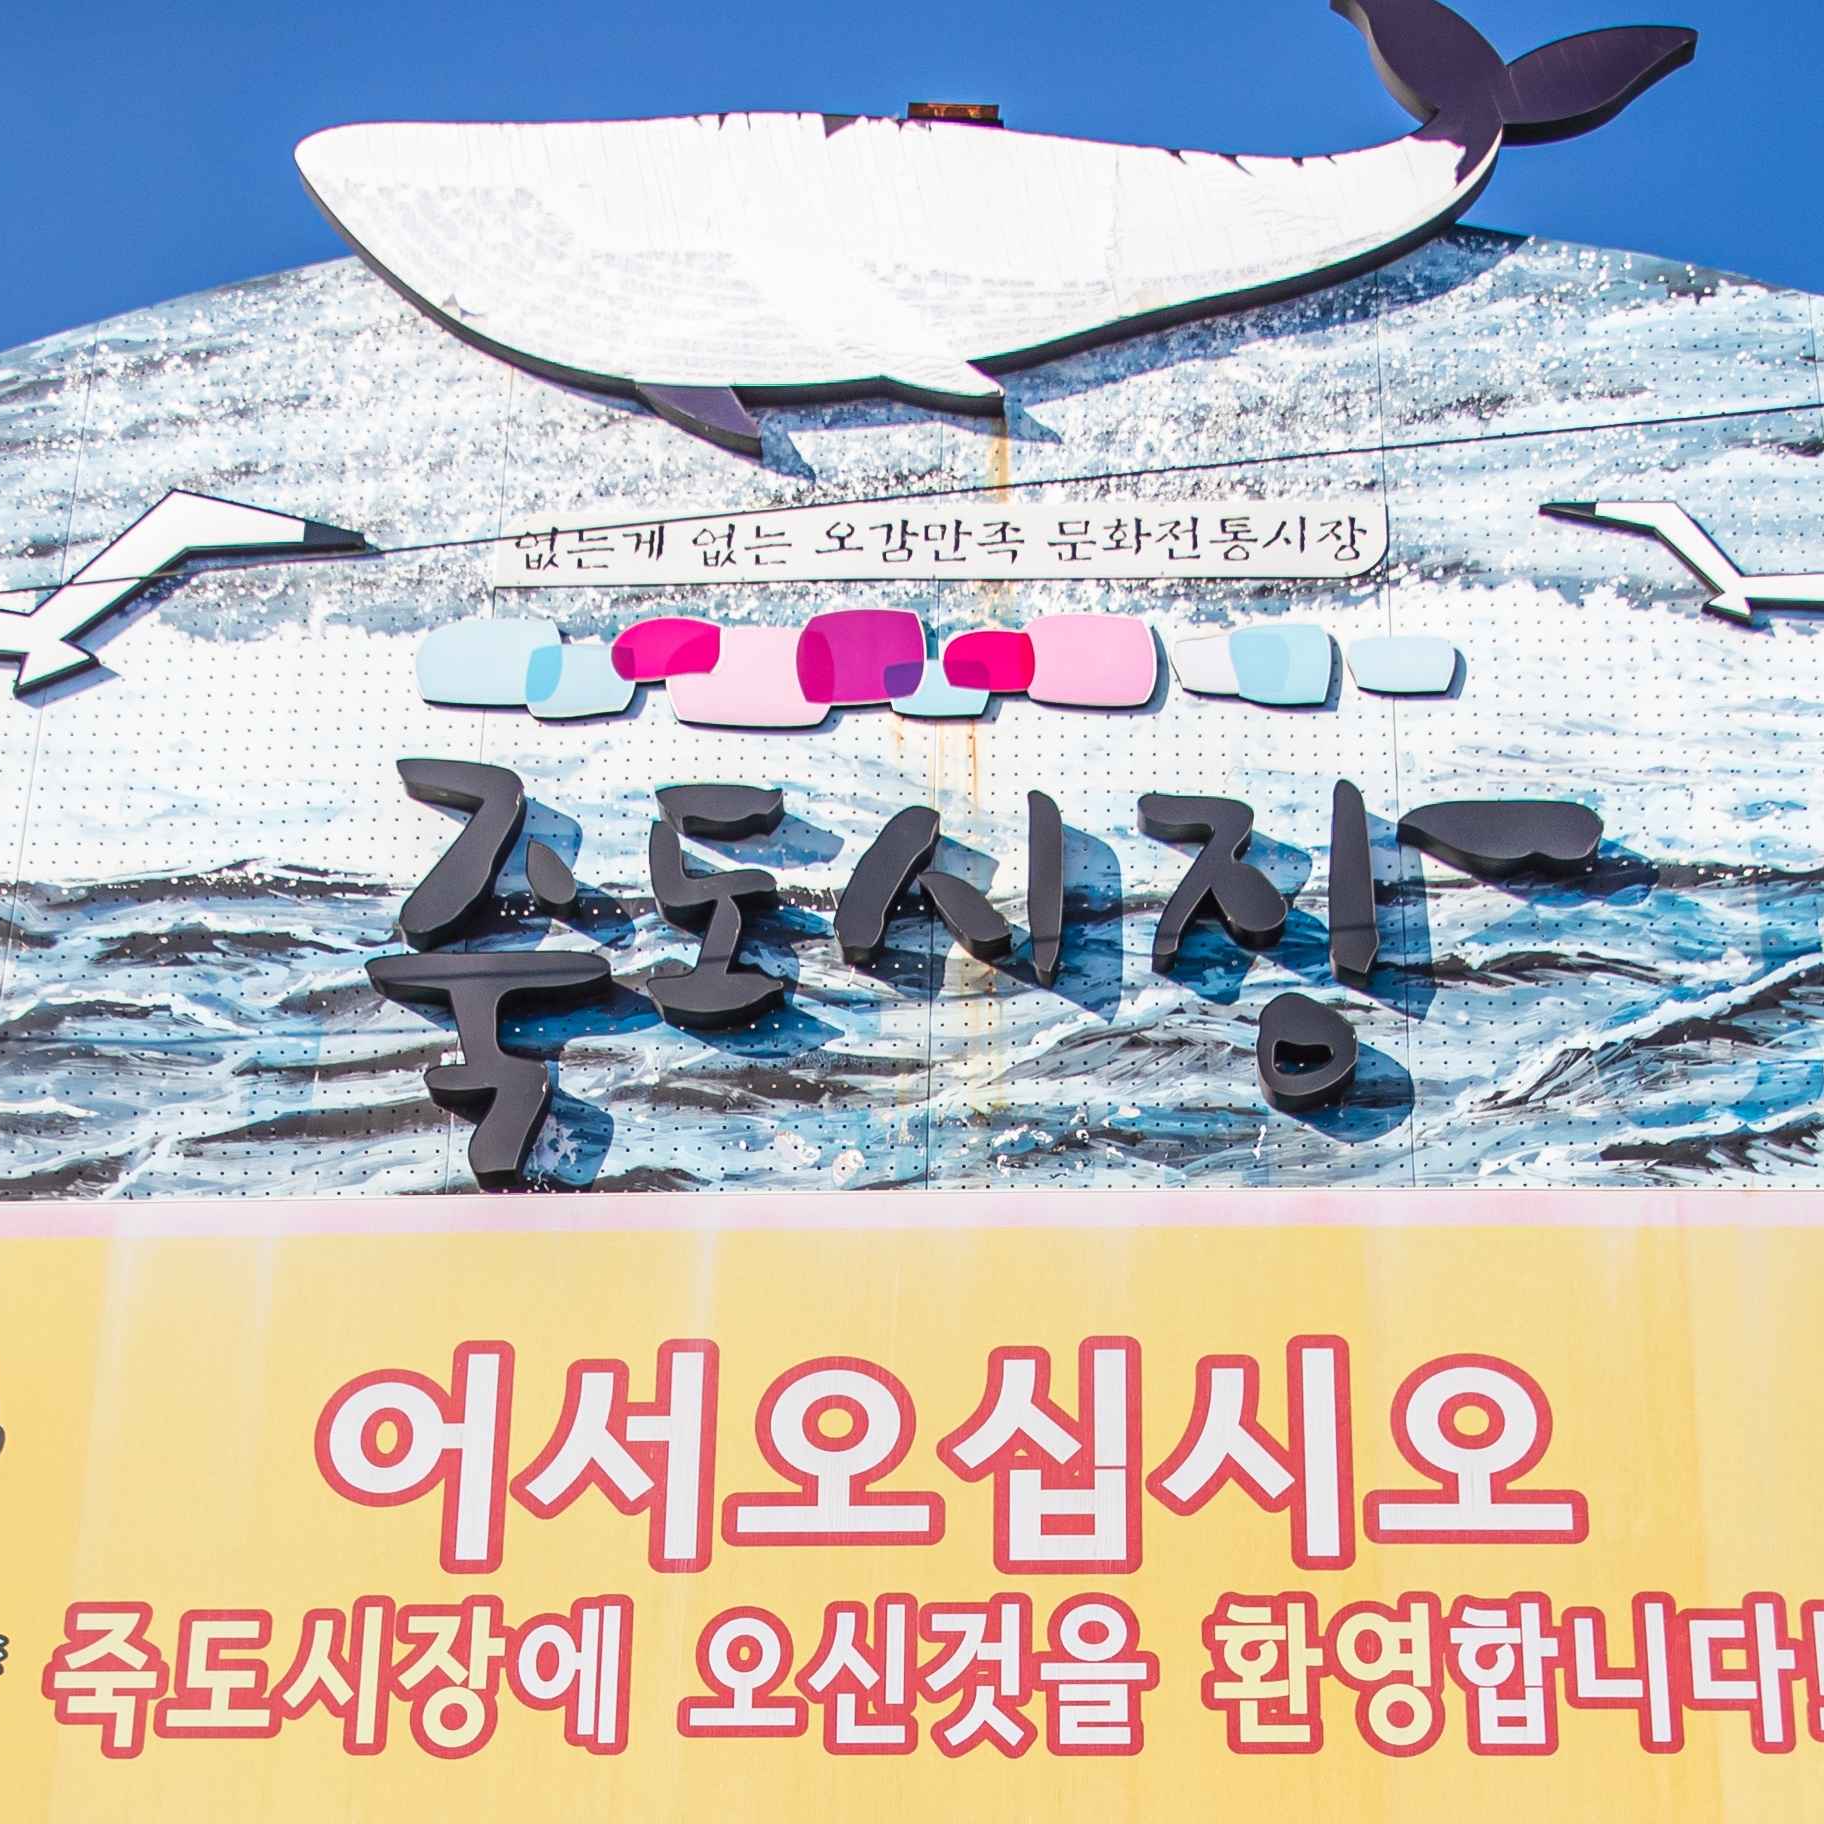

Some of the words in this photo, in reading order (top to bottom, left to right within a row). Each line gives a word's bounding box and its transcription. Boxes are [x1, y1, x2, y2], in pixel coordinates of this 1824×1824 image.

[692, 522, 793, 568] 없는
[814, 516, 1026, 565] 오감만족
[1047, 516, 1367, 562] 문화전통시장
[367, 757, 1604, 1192] 죽도시장
[314, 1335, 1589, 1575] 어서오십시오
[42, 1594, 634, 1759] 죽도시장에
[677, 1593, 1159, 1758] 오신것을
